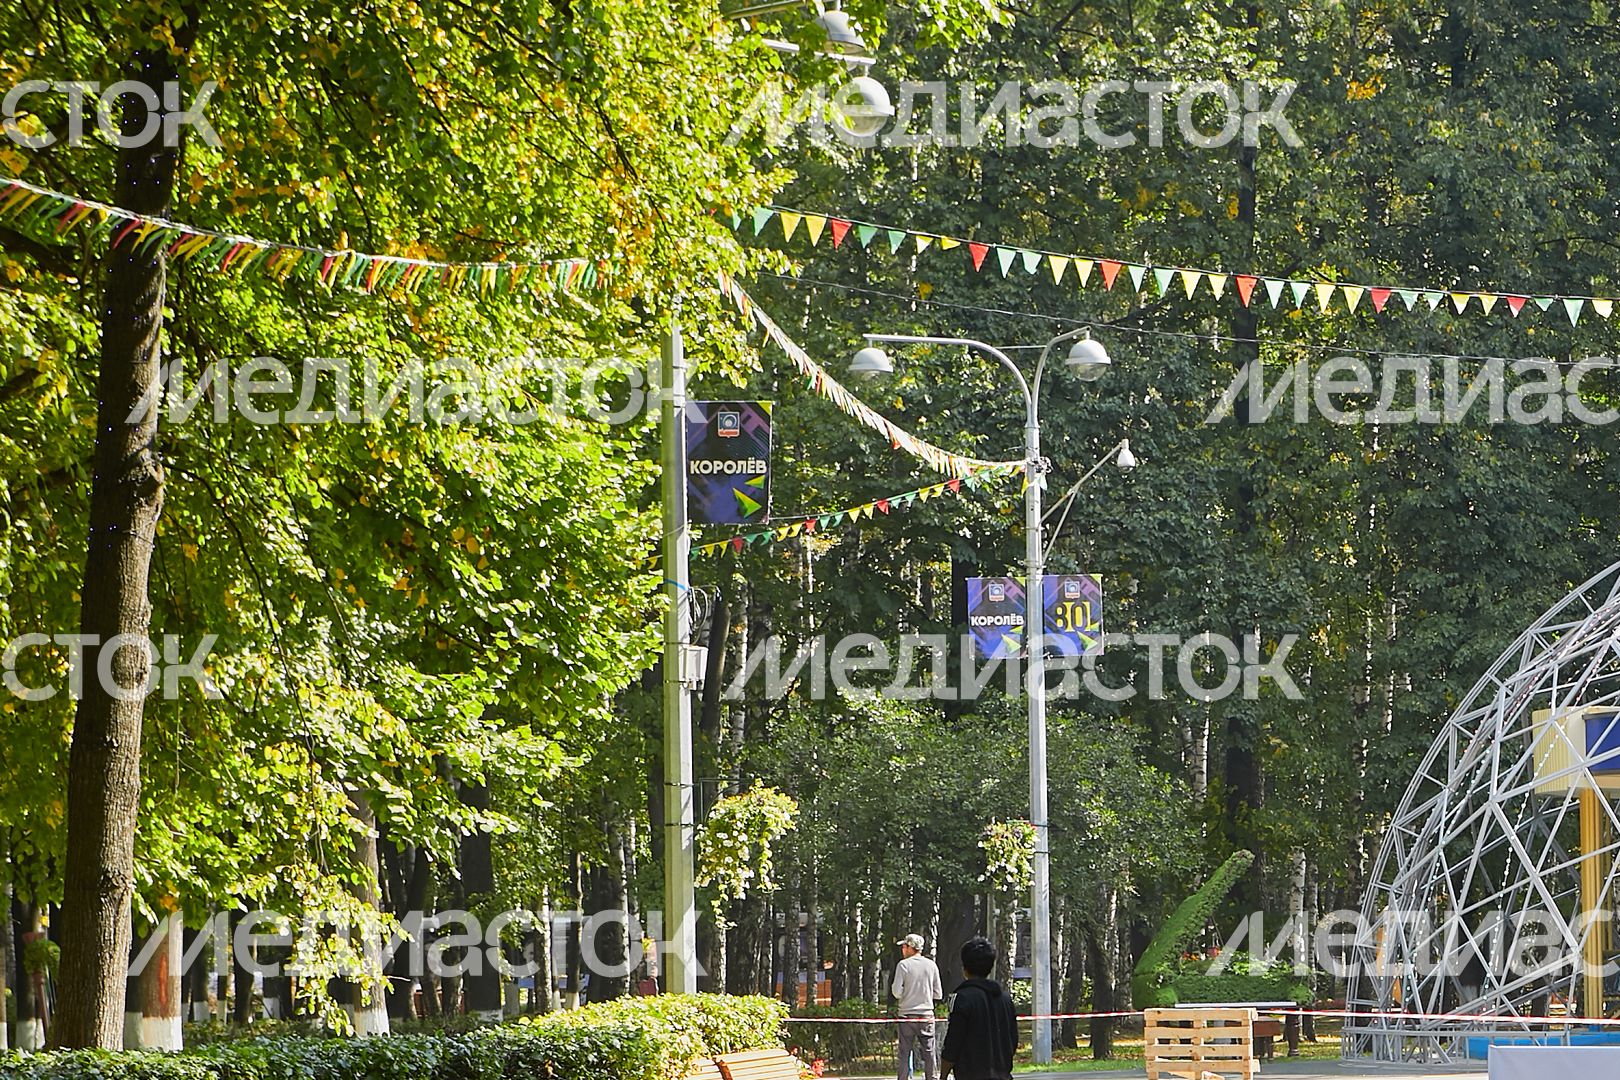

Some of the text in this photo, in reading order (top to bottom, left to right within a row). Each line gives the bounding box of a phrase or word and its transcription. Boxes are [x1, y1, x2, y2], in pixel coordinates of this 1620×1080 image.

[690, 457, 767, 474] КОРОЛЁВ
[971, 613, 1024, 626] КОРОЛЁВ
[1055, 601, 1091, 632] 80
